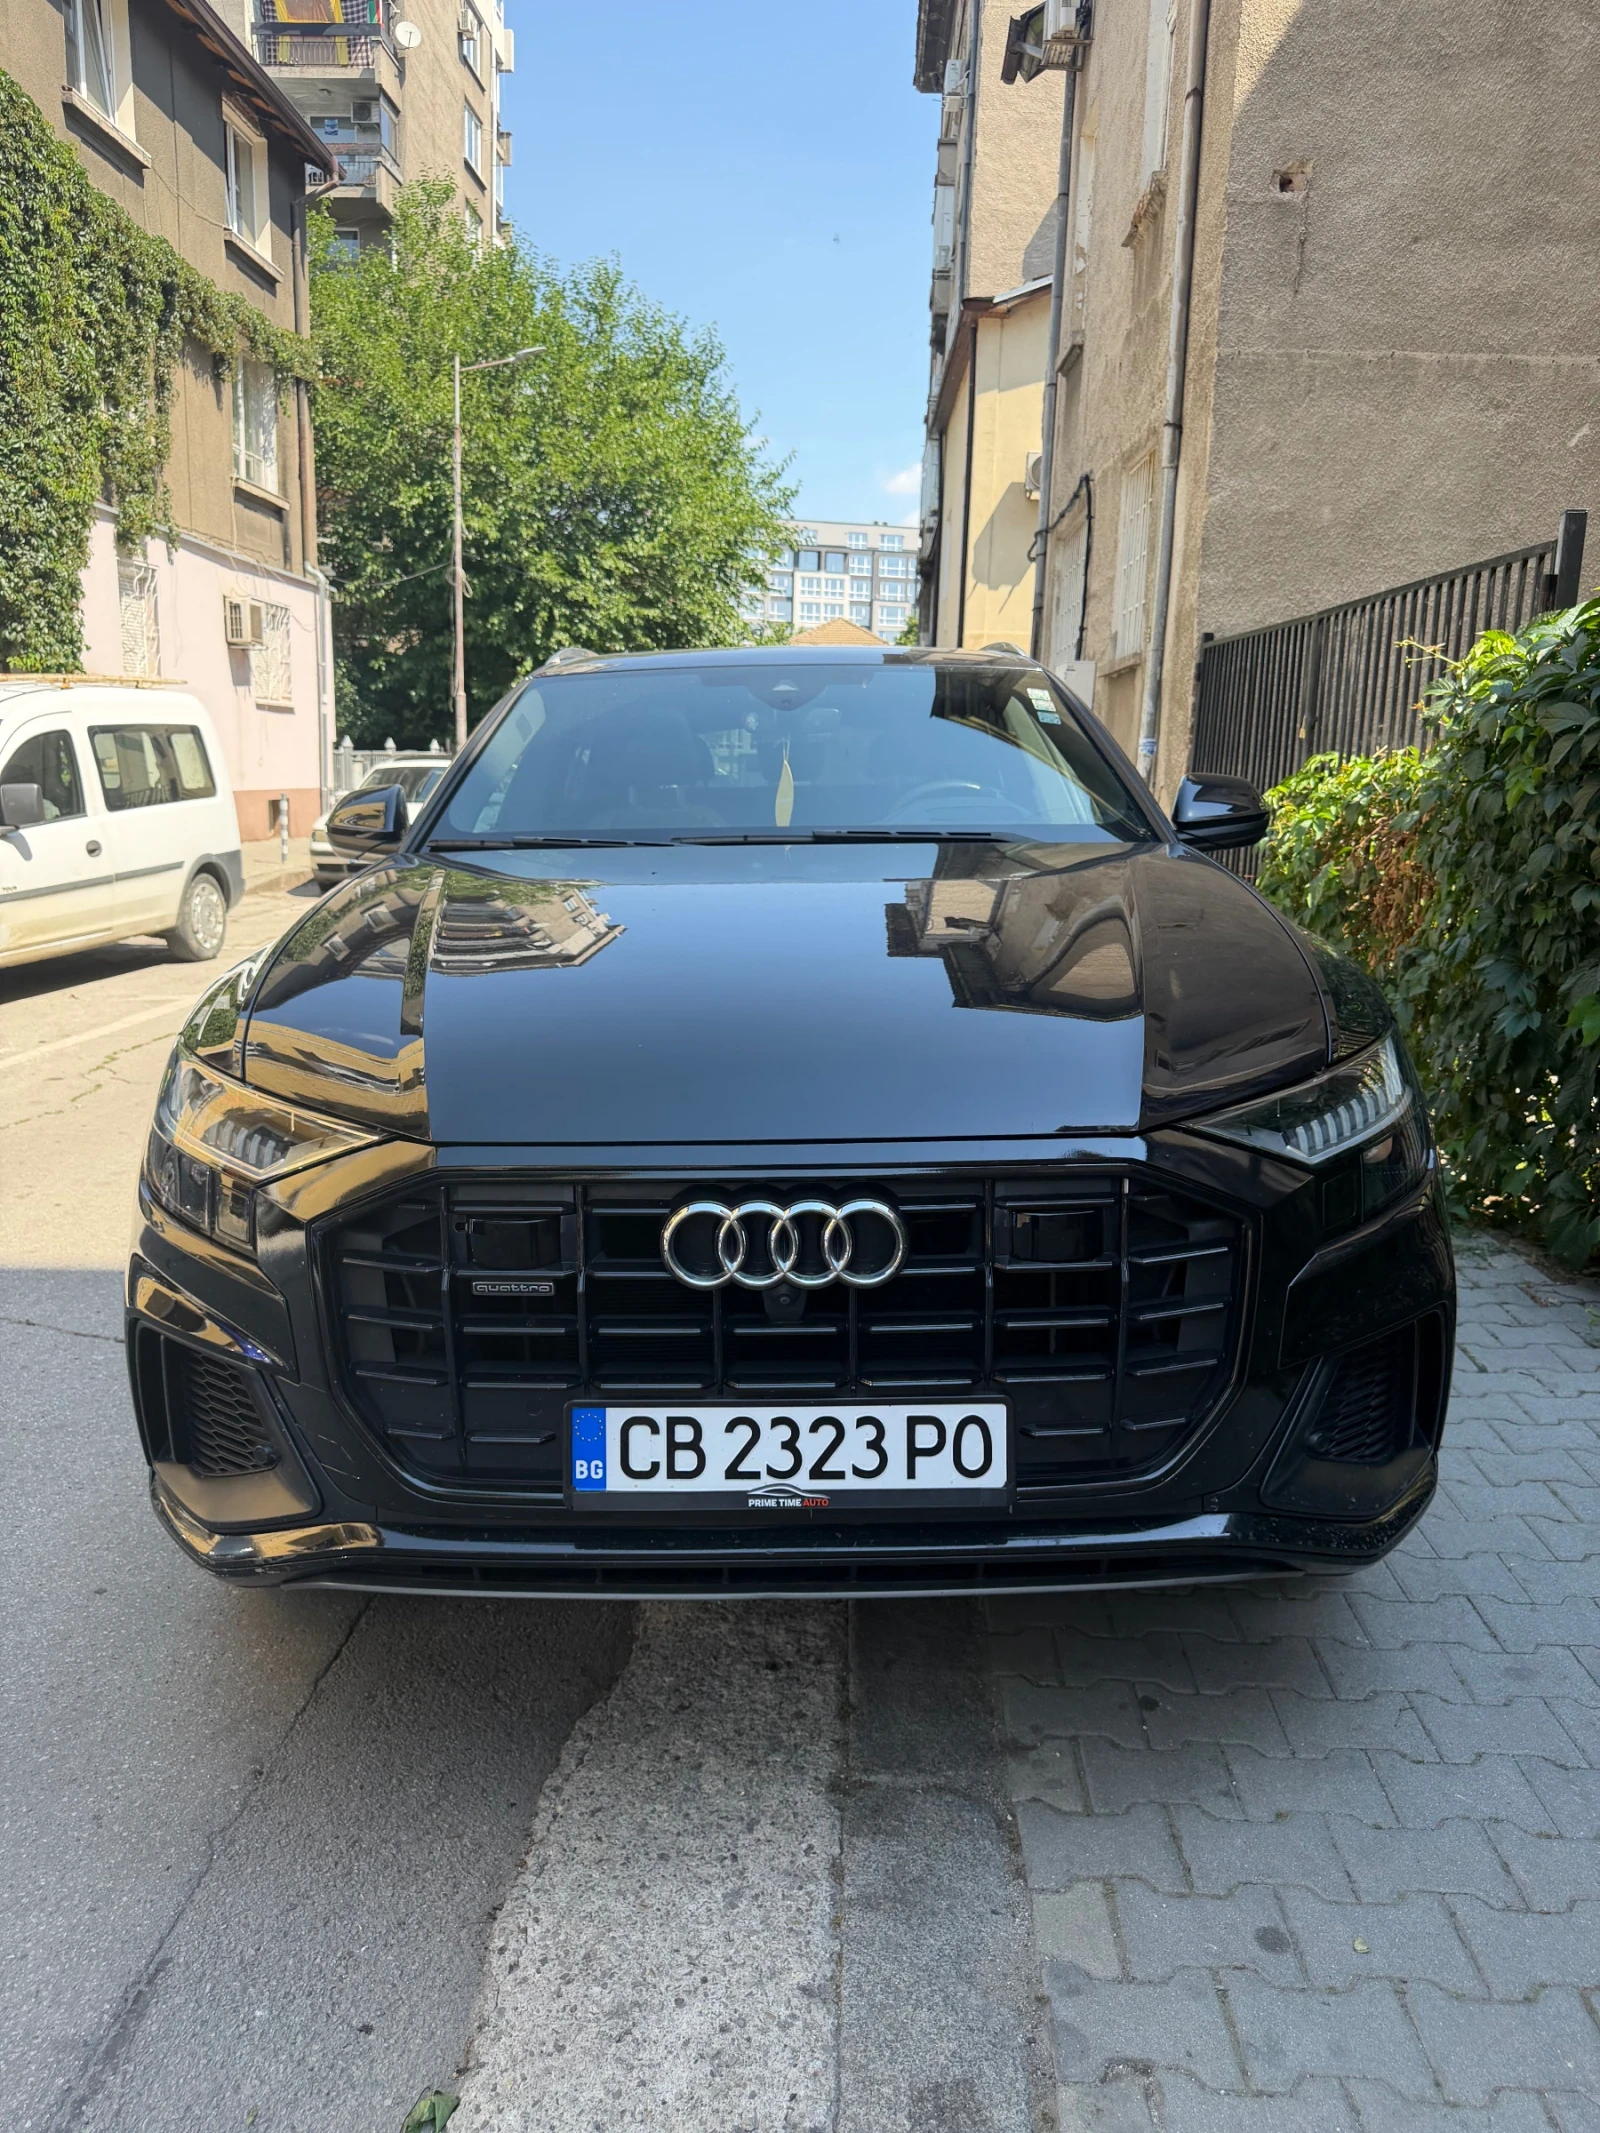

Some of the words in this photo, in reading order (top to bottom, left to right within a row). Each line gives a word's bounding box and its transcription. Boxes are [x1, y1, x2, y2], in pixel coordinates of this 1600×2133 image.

[476, 1284, 550, 1293] quattro
[620, 1416, 706, 1479] CB
[724, 1416, 888, 1480] 2323
[906, 1414, 993, 1480] PO
[575, 1460, 604, 1479] BG
[748, 1499, 777, 1507] PRIME
[779, 1499, 801, 1507] TIME
[803, 1499, 829, 1507] AUTO
